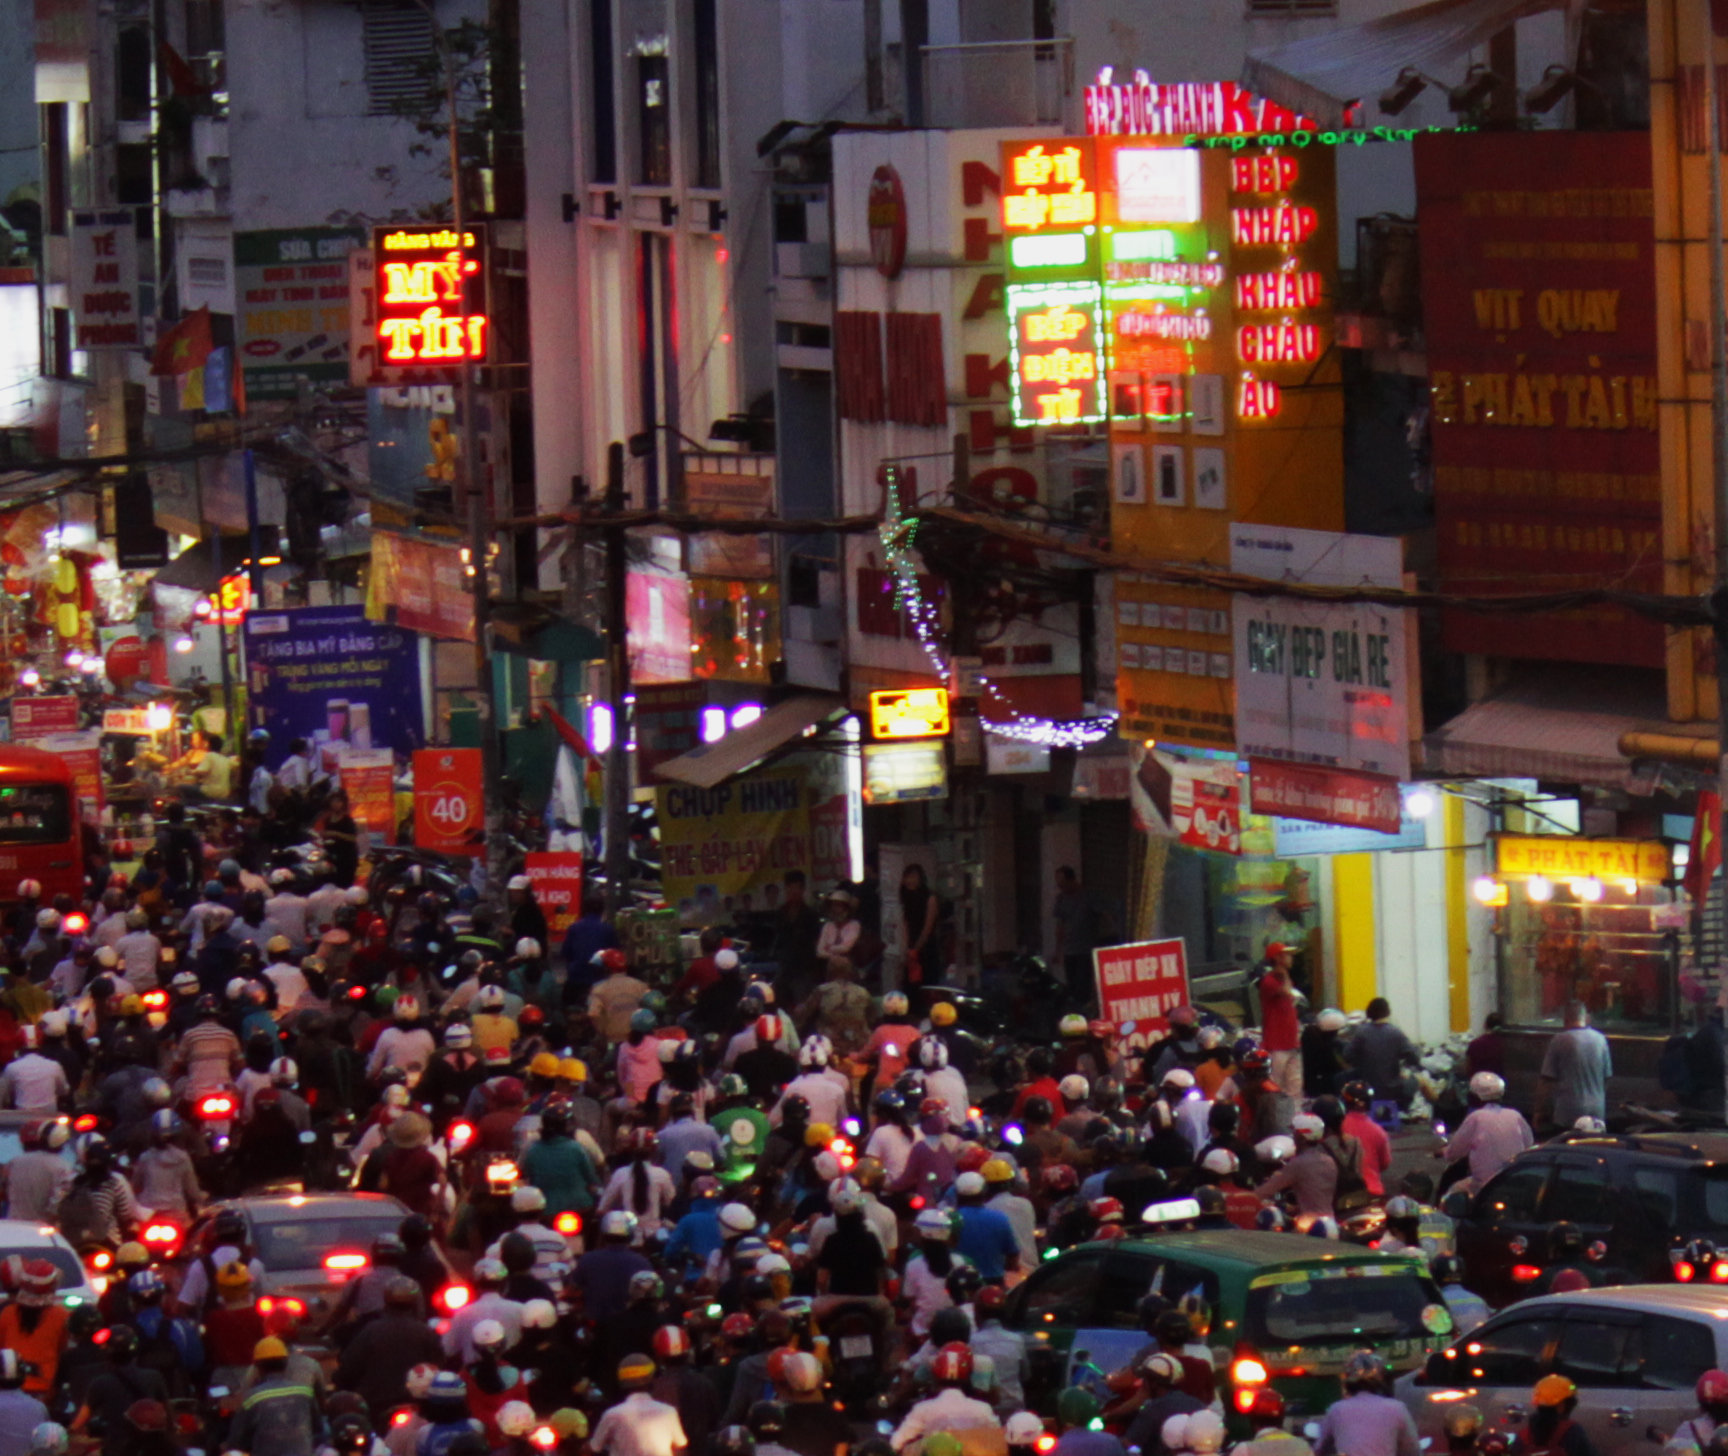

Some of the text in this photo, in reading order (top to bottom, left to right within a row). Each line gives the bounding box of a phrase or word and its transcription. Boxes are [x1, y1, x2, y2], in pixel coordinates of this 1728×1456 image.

[1231, 147, 1299, 193] BẾP
[1231, 198, 1319, 252] NHẬP
[1237, 256, 1322, 310] KHẨU
[1536, 289, 1620, 339] QUAY
[1237, 316, 1322, 363] CHÂU
[1237, 371, 1280, 417] ÂU
[430, 796, 467, 823] 40
[1527, 842, 1640, 874] PHÁT TÀI
[1109, 995, 1162, 1023] THANH
